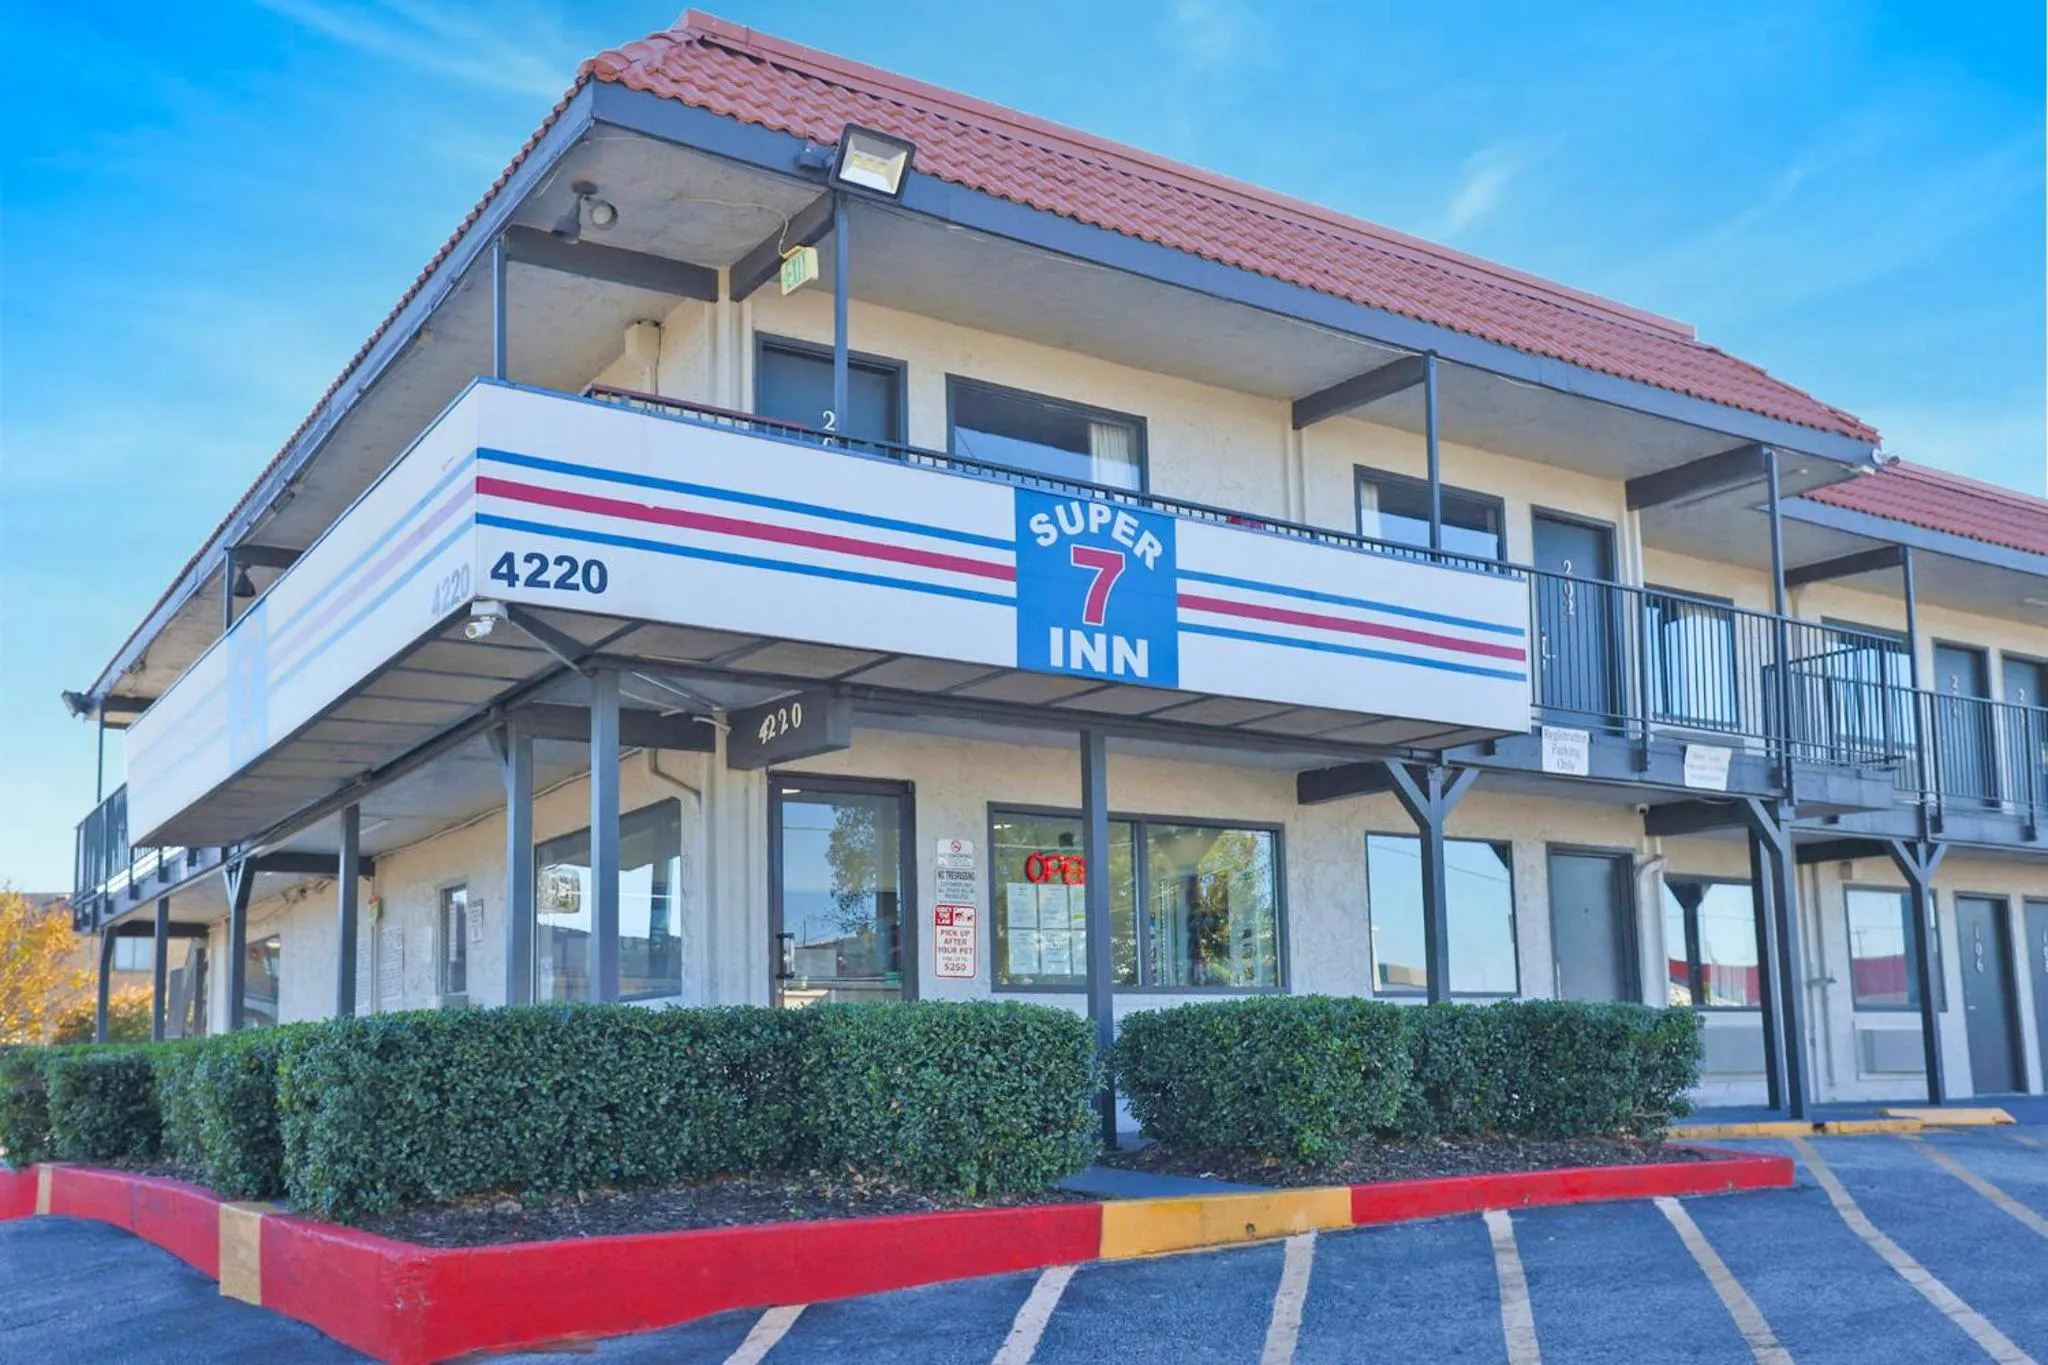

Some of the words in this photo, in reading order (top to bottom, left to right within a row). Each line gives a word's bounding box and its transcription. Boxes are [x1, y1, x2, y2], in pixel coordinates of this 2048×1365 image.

[1029, 501, 1163, 571] SUPER
[431, 562, 470, 617] 4220
[490, 551, 608, 595] 4220
[1070, 543, 1126, 627] 7
[1050, 626, 1149, 678] INN
[758, 702, 802, 745] 4220
[1026, 852, 1086, 885] OPE
[938, 946, 957, 954] YOUR
[959, 947, 972, 955] PET
[941, 929, 957, 937] PICK
